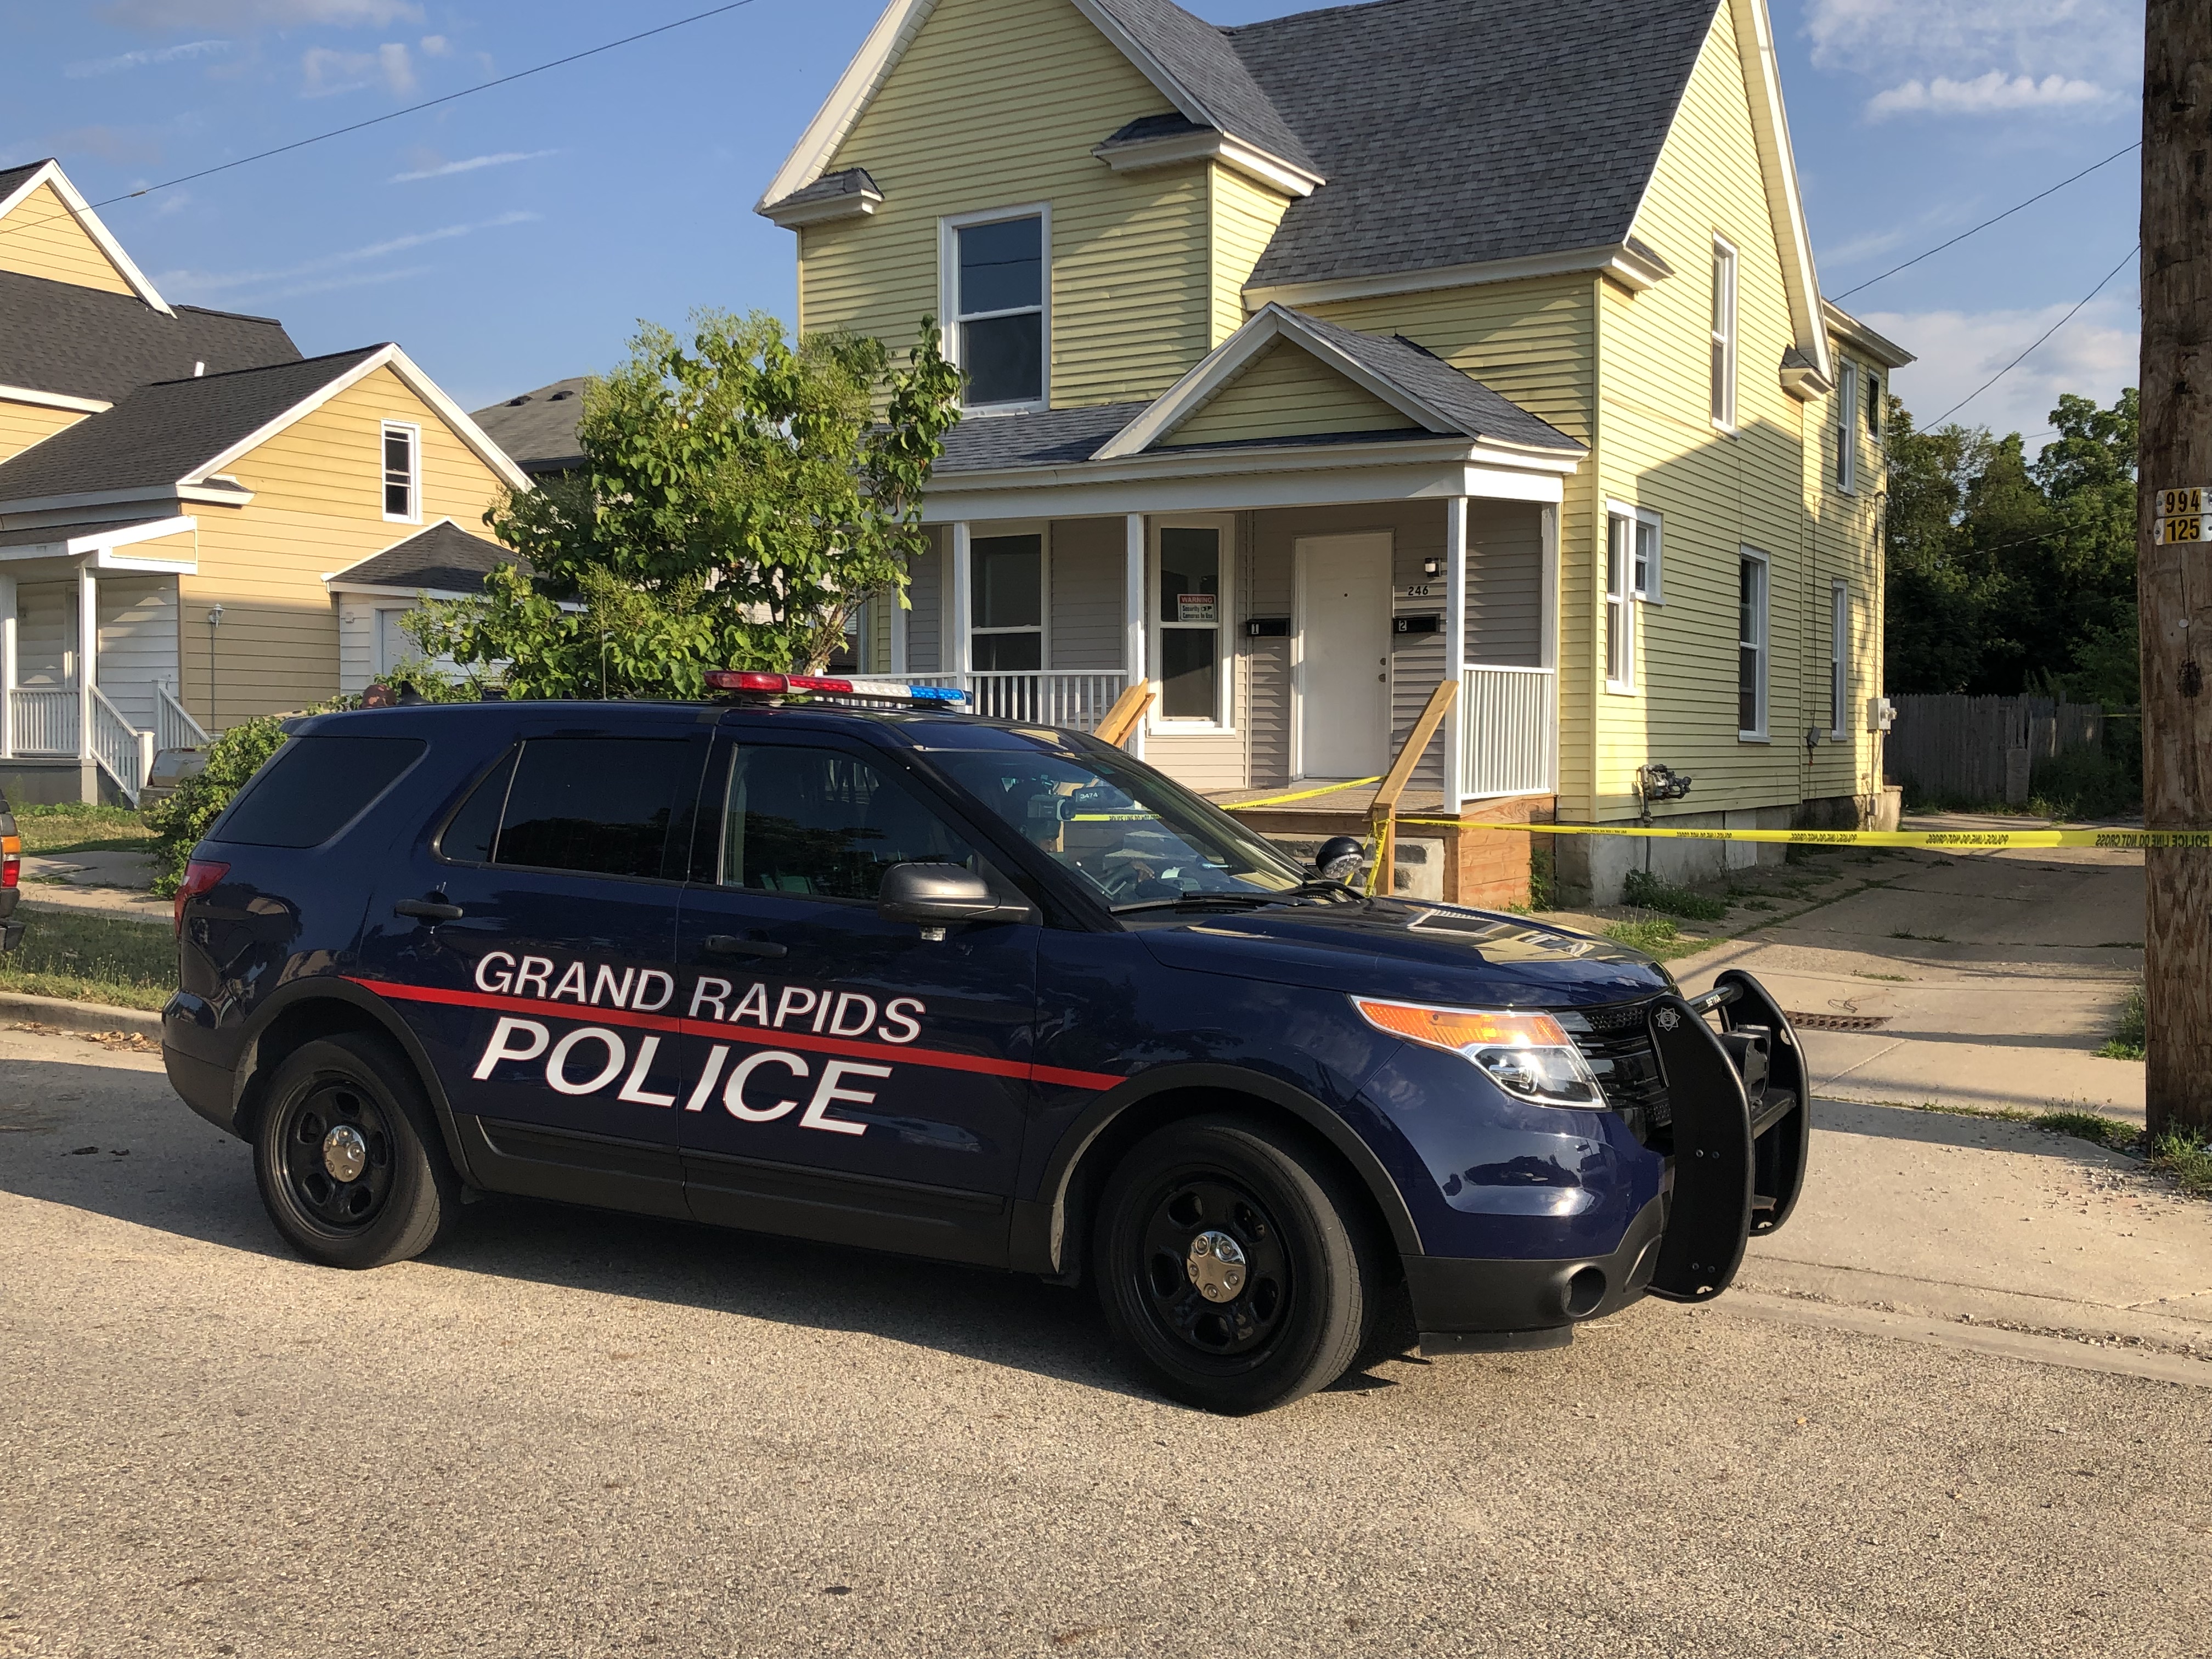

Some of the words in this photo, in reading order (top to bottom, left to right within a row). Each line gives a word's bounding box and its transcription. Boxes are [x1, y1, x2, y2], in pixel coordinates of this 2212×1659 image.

[2166, 490, 2200, 514] 994
[2166, 518, 2200, 541] 125
[1408, 585, 1429, 596] 246
[1252, 624, 1257, 634] 1
[1400, 620, 1406, 630] 2
[475, 951, 675, 1012] GRAND
[689, 975, 927, 1044] RAPIDS
[472, 1017, 893, 1137] POLICE
